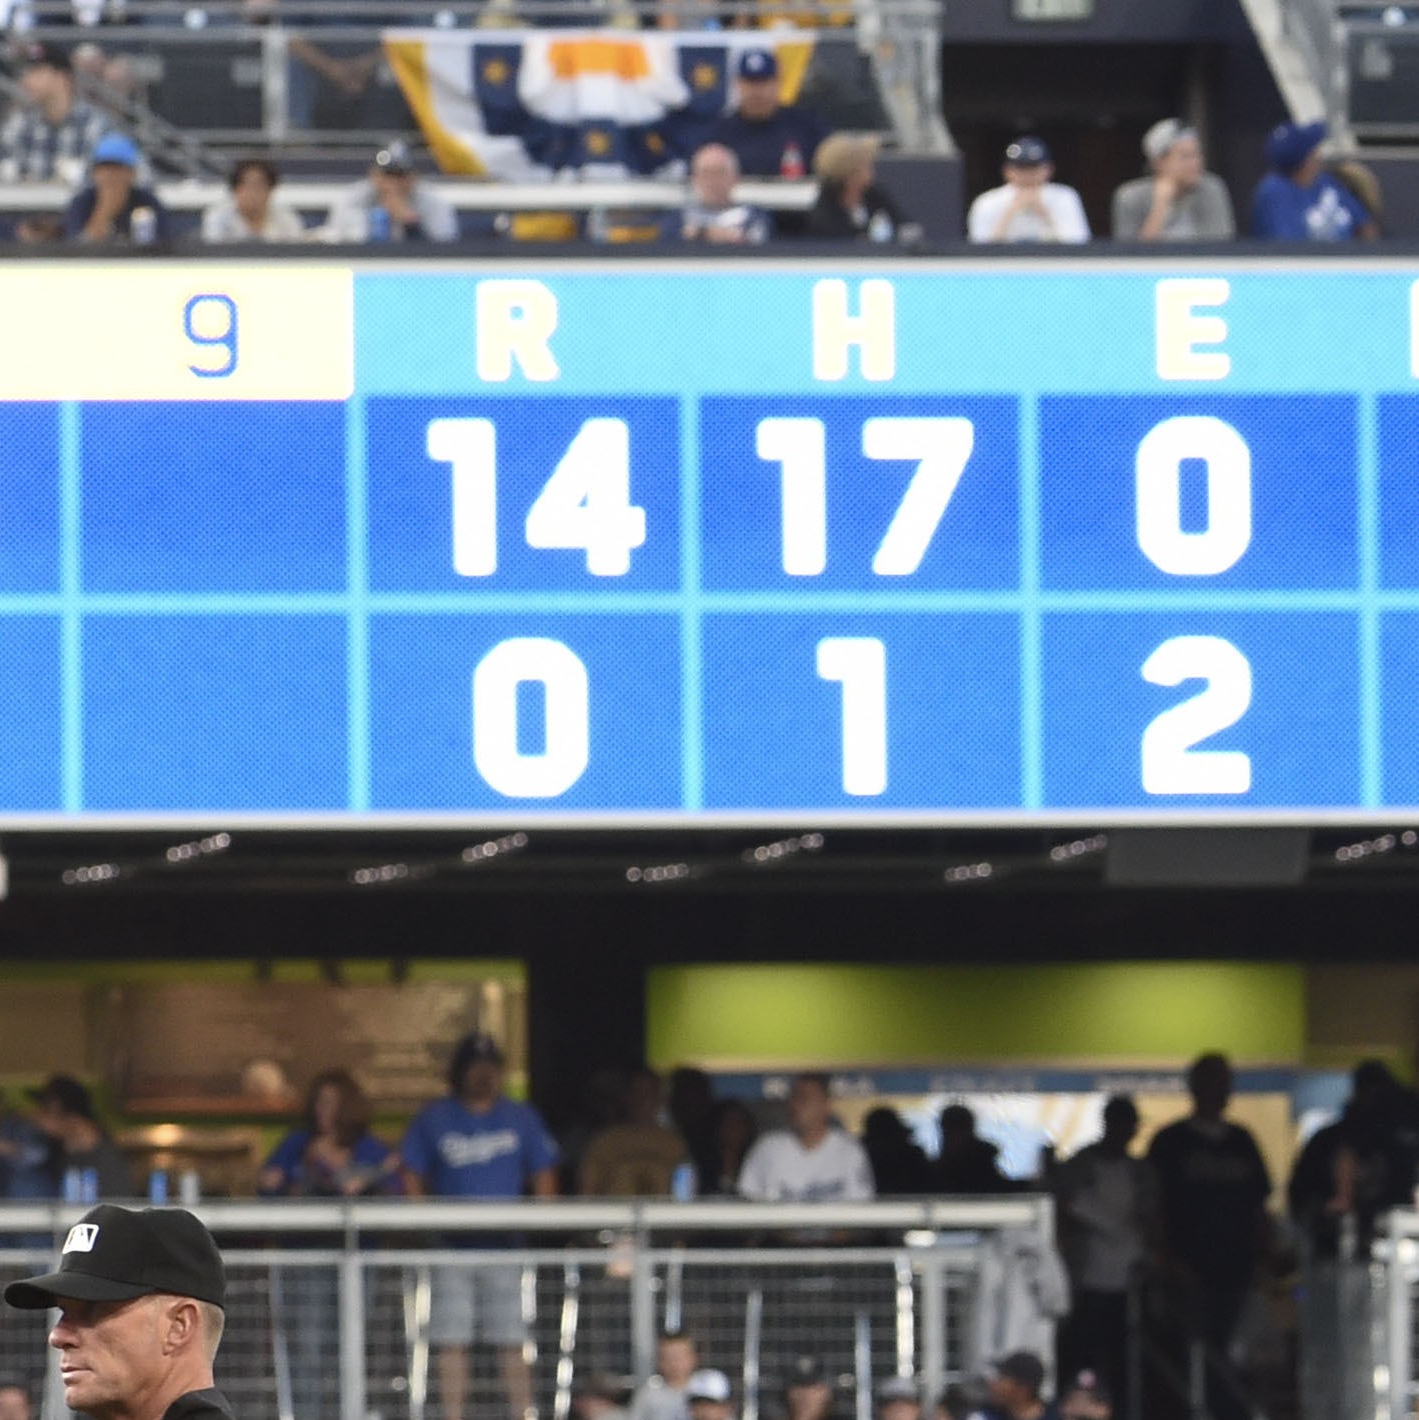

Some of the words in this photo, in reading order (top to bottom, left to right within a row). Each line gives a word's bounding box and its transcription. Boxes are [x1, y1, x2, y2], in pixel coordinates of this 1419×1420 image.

[182, 293, 240, 380] 9
[475, 278, 561, 383] R
[811, 278, 897, 383] H
[1154, 277, 1232, 382] E
[427, 418, 646, 577] 14
[756, 417, 974, 576] 17
[1136, 416, 1252, 576] 0
[473, 637, 590, 799] 0
[816, 637, 887, 796] 1
[1141, 635, 1252, 795] 2
